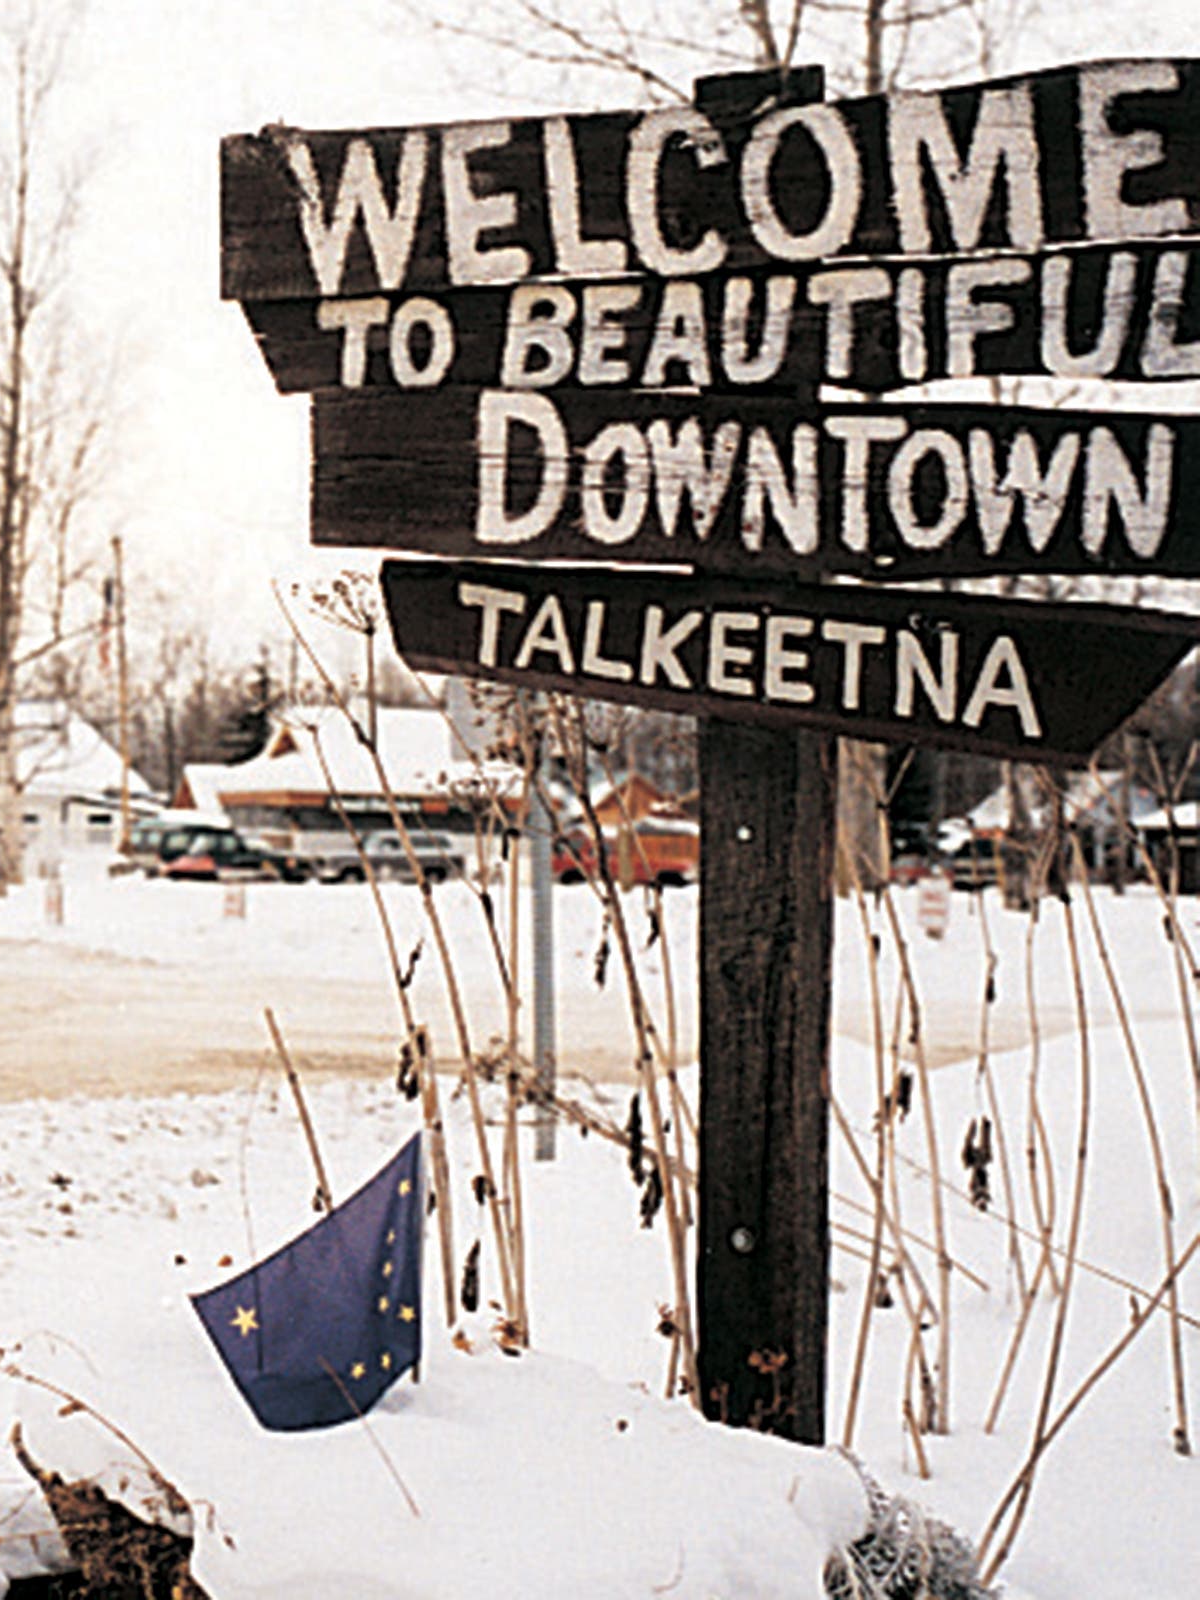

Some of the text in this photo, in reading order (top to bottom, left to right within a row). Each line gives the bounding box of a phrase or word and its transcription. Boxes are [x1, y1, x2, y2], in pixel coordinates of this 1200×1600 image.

[289, 62, 1190, 294] WELCOME
[318, 251, 1200, 391] TO BEAUTIFUL
[477, 392, 1175, 558] DOWNTOWN
[459, 583, 1043, 737] TALKEETNA
